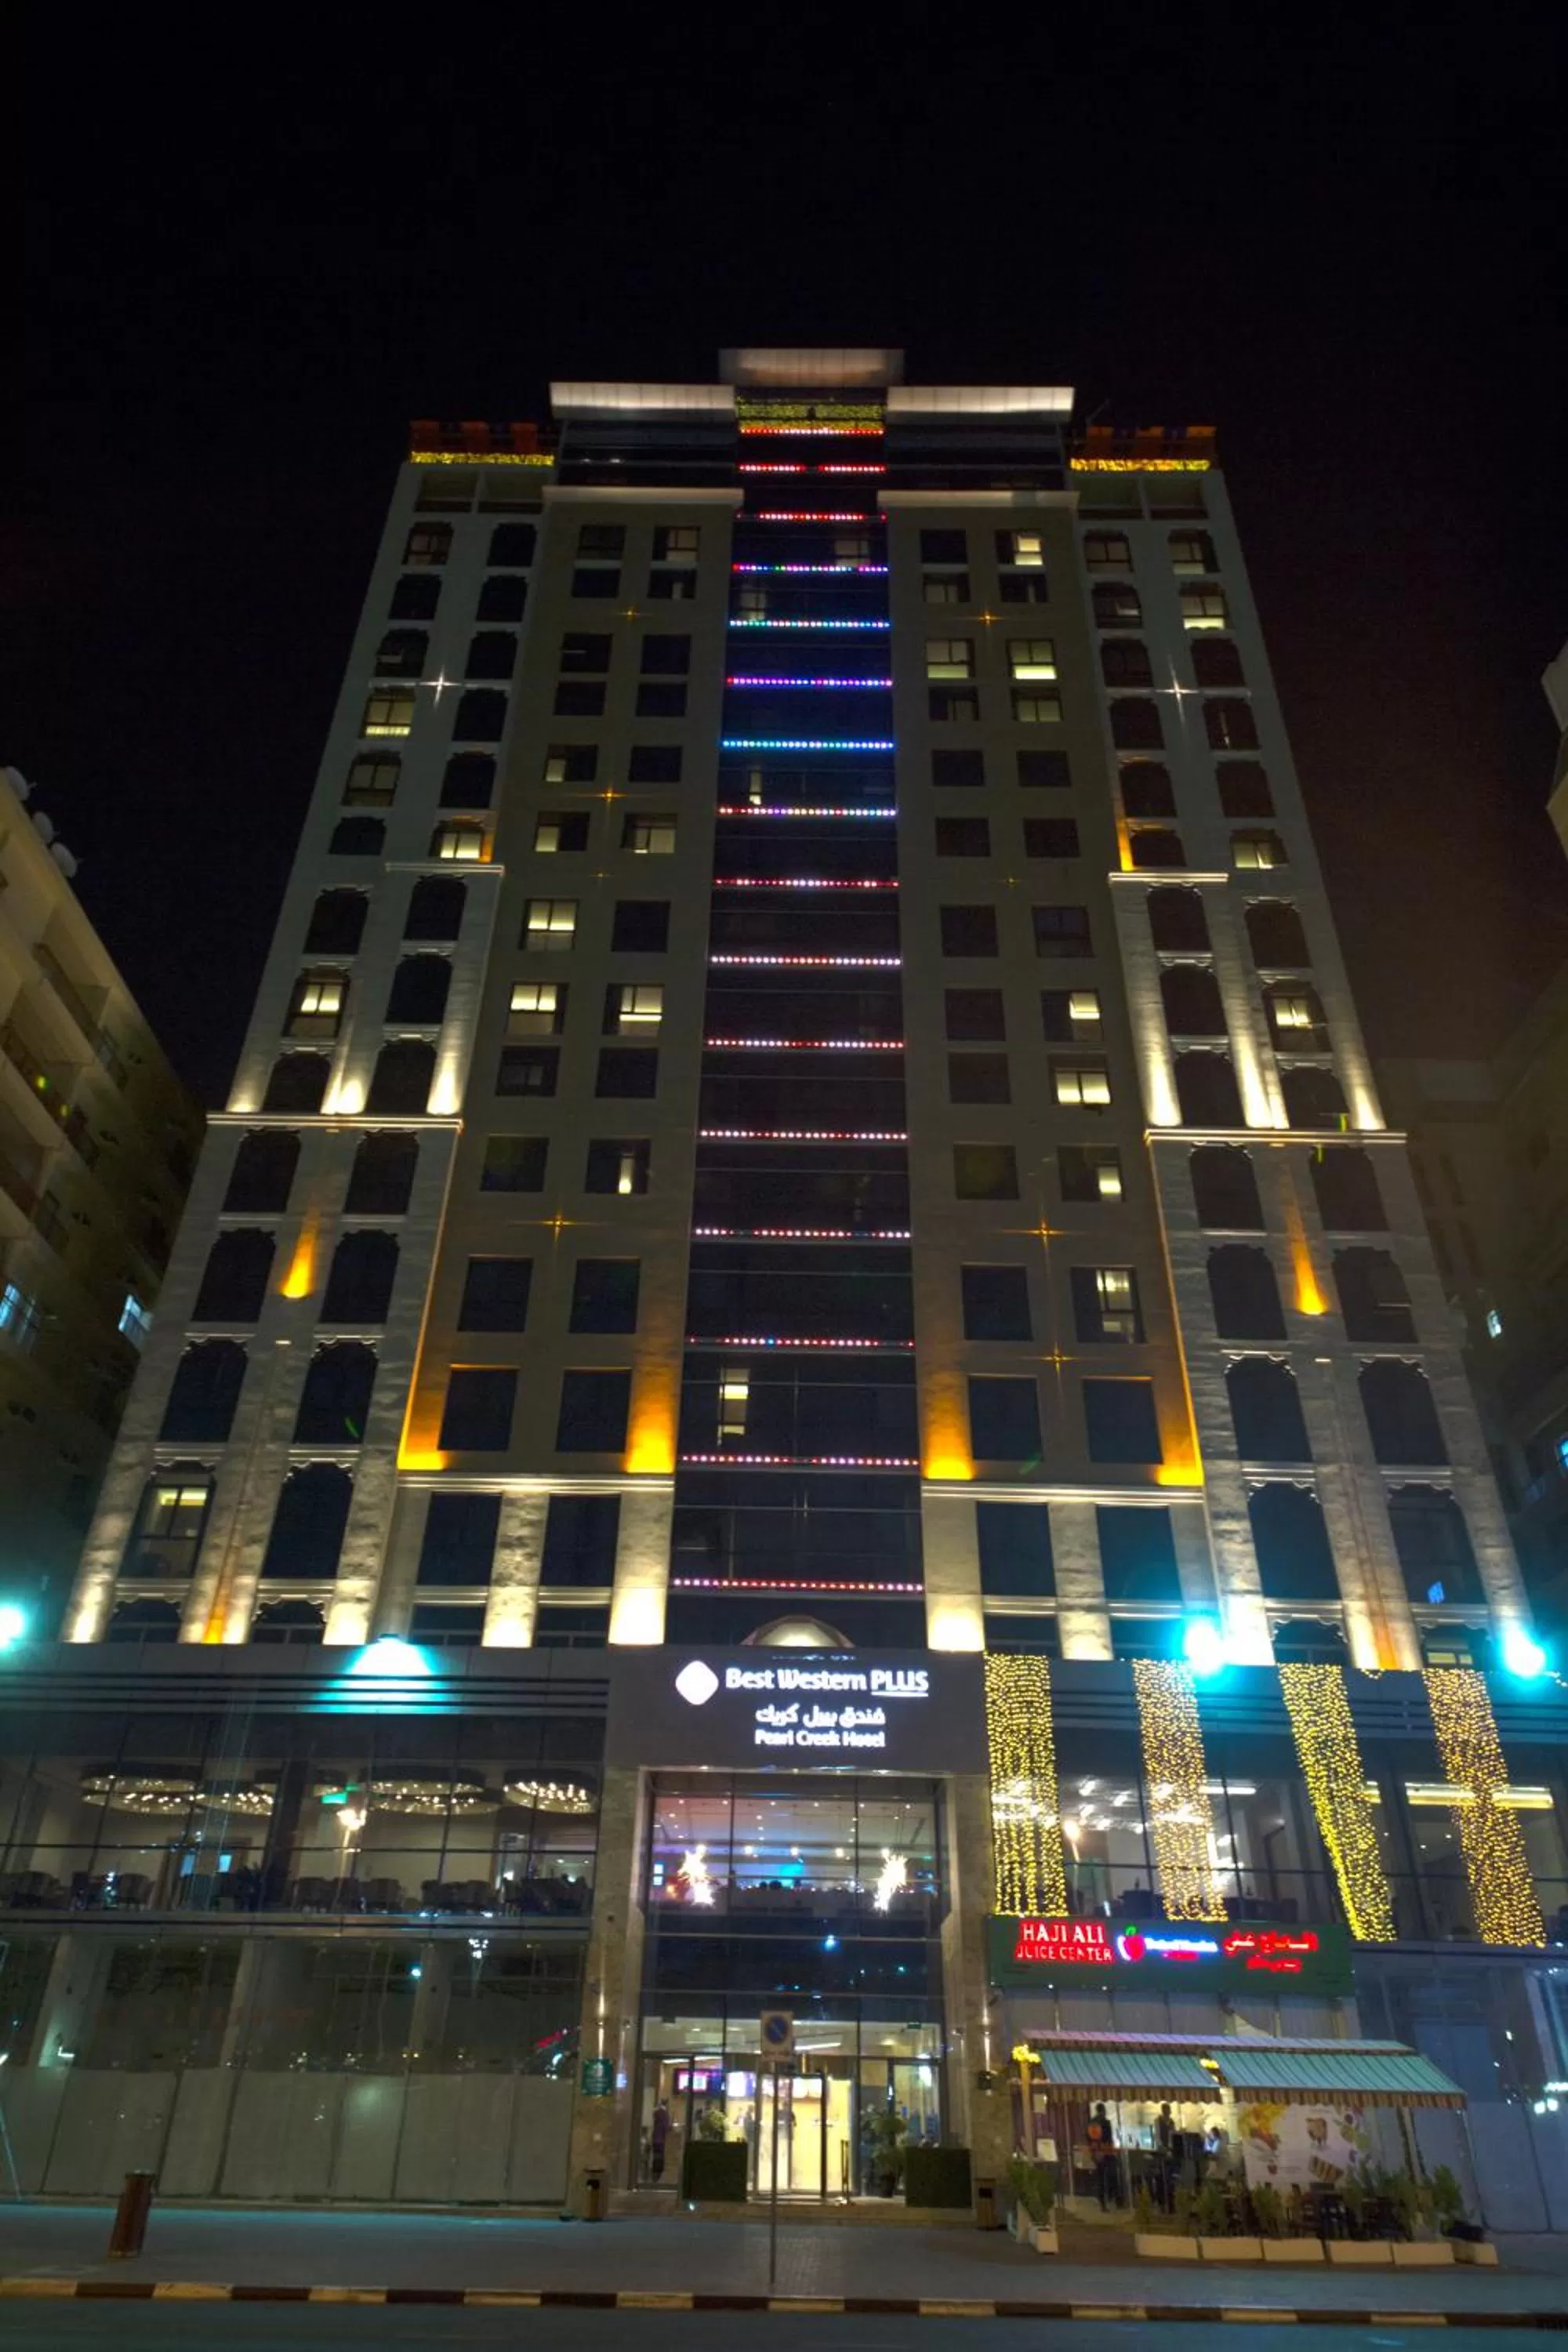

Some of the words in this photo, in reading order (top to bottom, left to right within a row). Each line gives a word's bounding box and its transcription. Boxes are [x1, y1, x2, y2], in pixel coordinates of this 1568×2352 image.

[725, 1668, 775, 1689] Best
[777, 1668, 867, 1690] Western
[871, 1670, 929, 1692] PLUS
[840, 1706, 886, 1727] فندق
[755, 1730, 794, 1746] Pearl
[796, 1730, 840, 1747] Creek
[842, 1731, 886, 1748] Hotel
[1022, 1922, 1067, 1943] HAJI
[1073, 1925, 1105, 1944] ALI
[1059, 1947, 1113, 1962] CENTER
